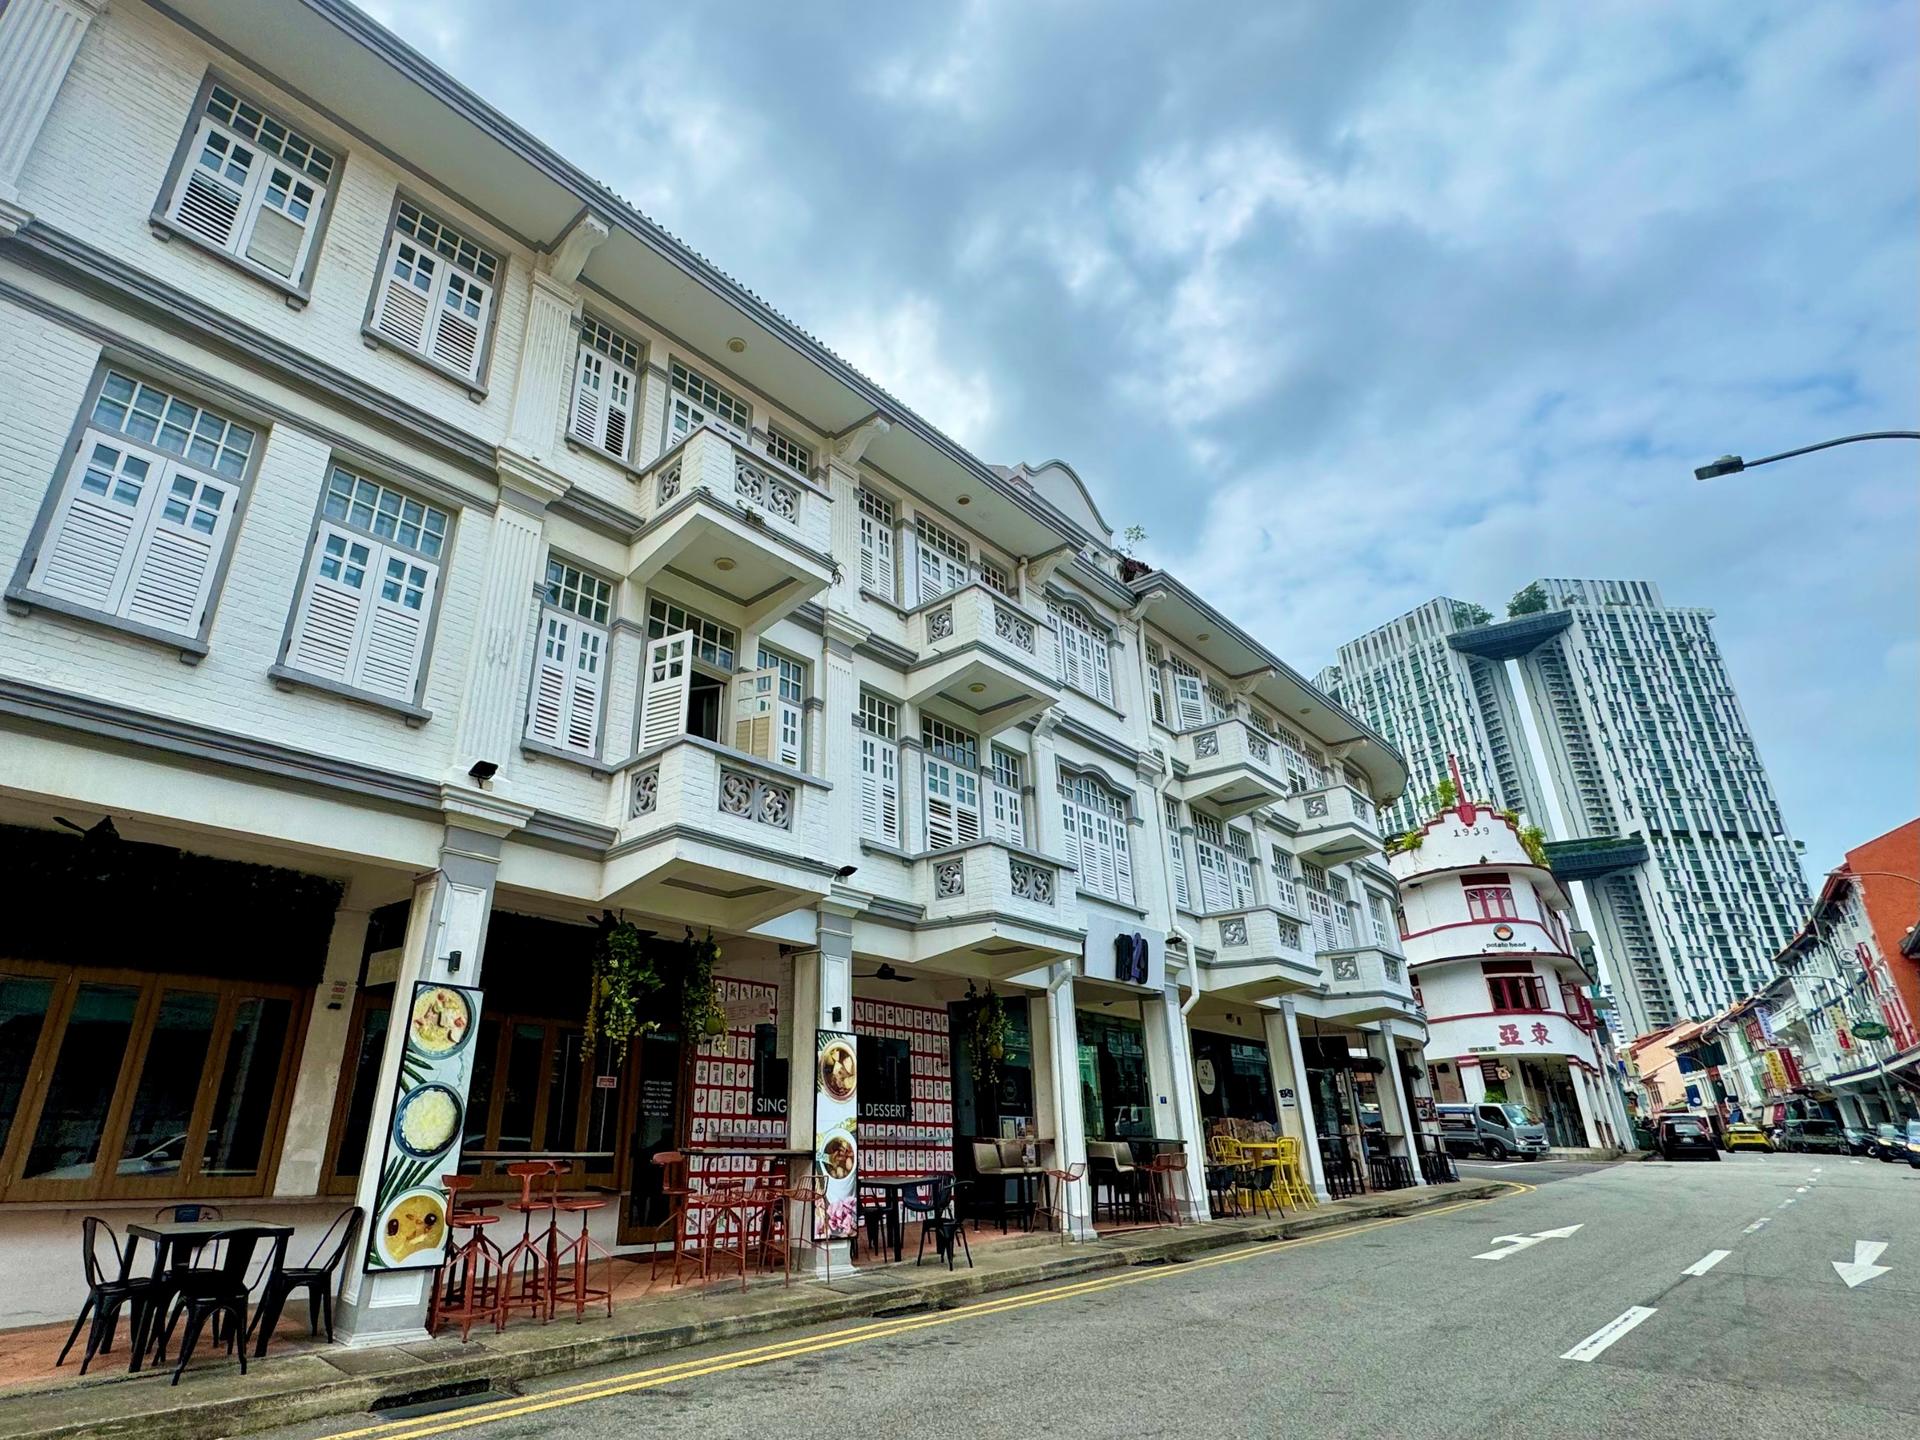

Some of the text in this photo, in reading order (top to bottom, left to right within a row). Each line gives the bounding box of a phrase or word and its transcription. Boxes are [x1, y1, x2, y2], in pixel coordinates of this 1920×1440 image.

[1453, 826, 1490, 838] 1939
[756, 1097, 787, 1113] SING
[866, 1103, 907, 1118] DESSERT
